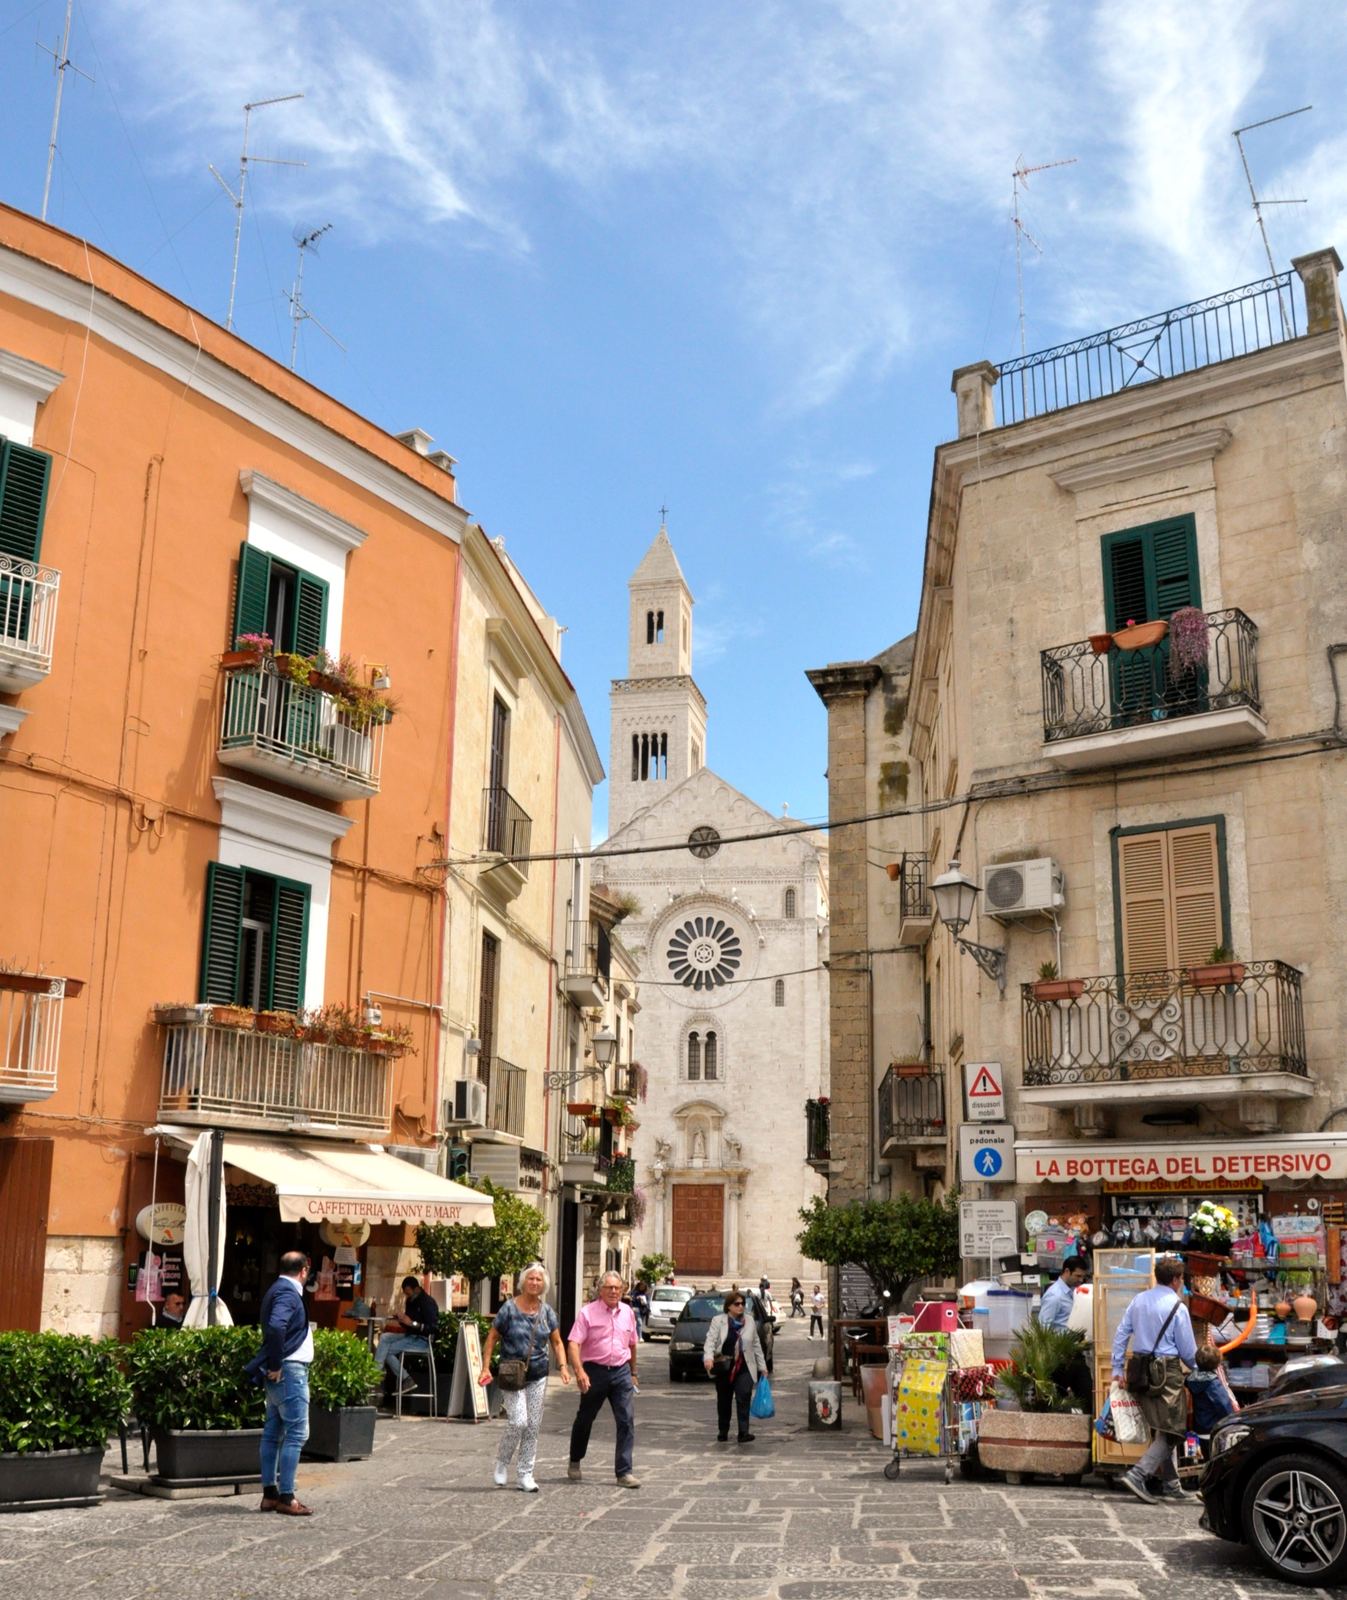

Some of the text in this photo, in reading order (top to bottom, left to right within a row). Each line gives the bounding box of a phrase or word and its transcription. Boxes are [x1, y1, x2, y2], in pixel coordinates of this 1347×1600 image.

[1035, 1153, 1332, 1176] LA BOTTEGA DEL DETERSIVO
[308, 1200, 462, 1219] CAFFETTERIA VANNY E MARY
